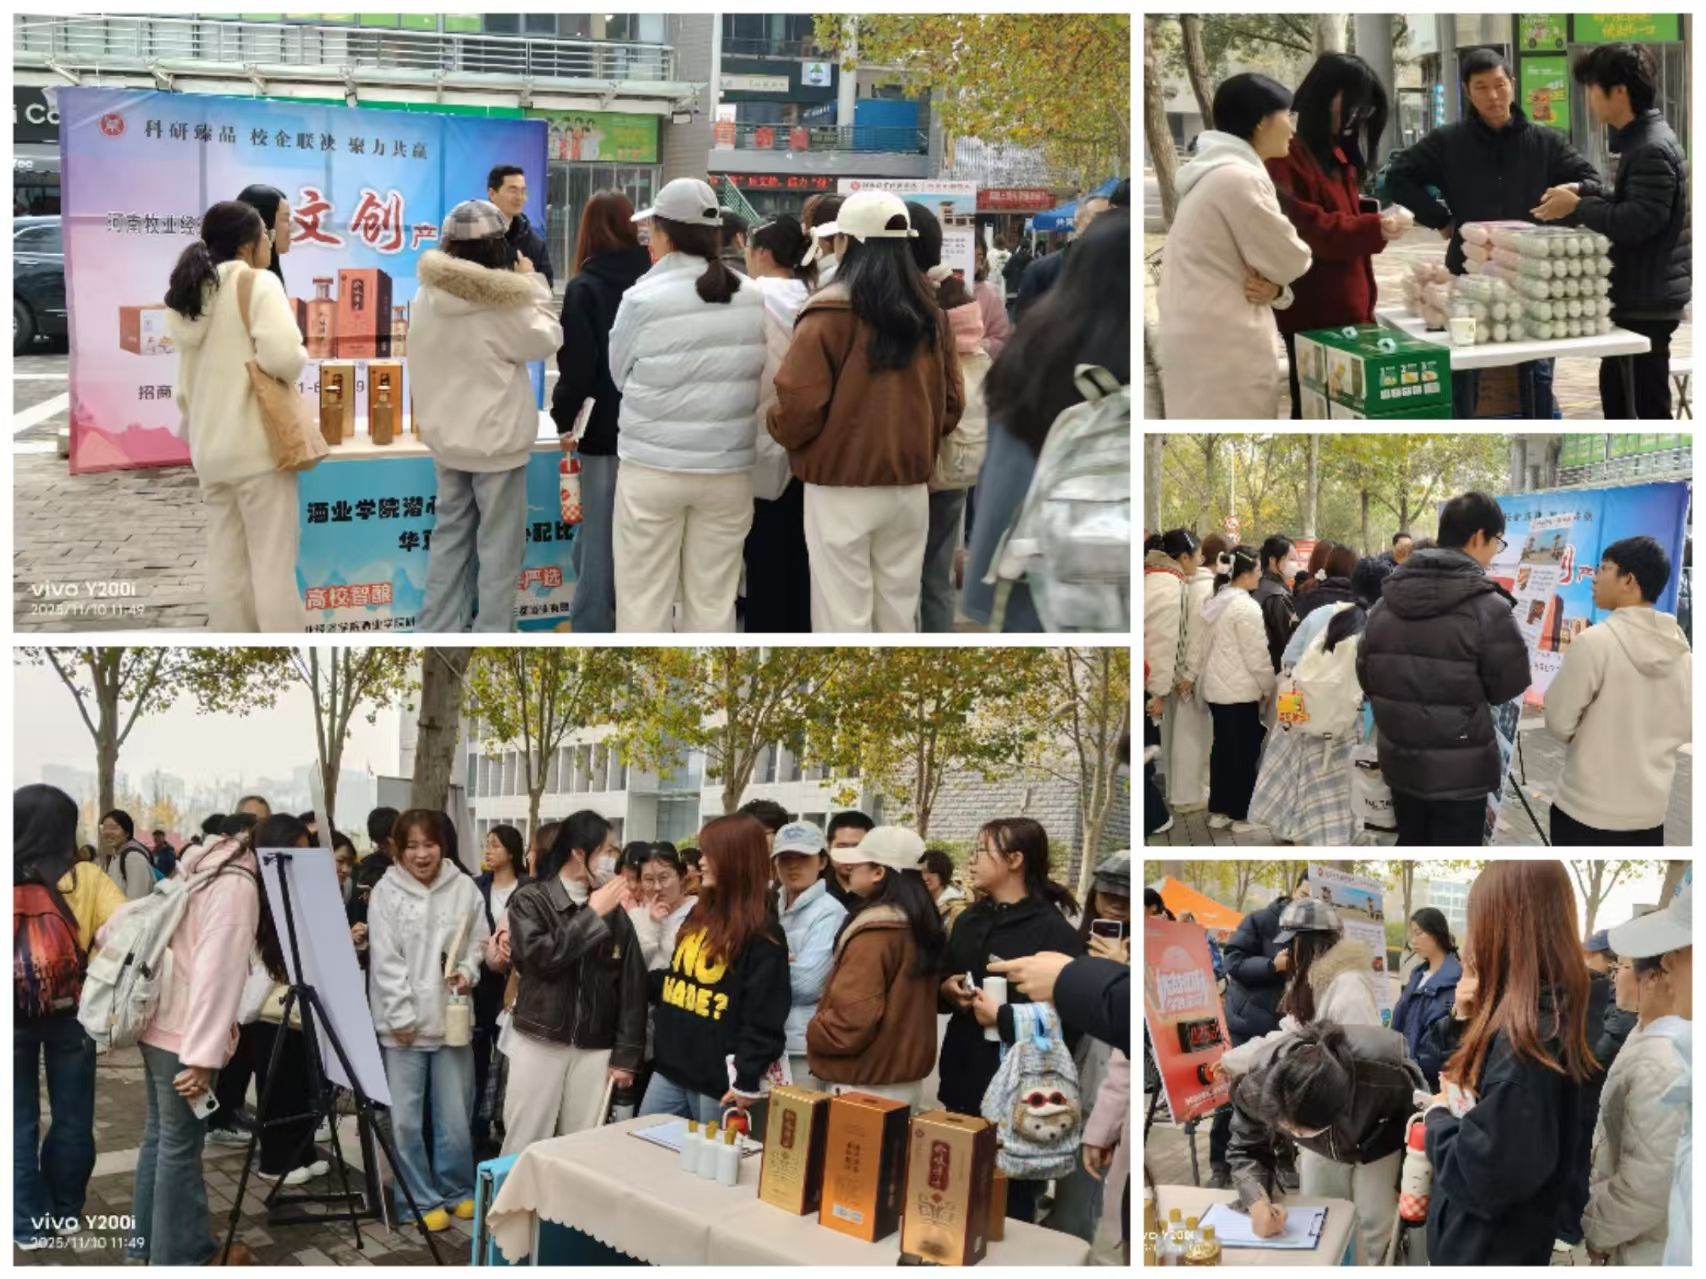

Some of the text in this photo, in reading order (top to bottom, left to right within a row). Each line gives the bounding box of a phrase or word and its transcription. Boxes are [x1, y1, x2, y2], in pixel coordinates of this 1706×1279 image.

[144, 119, 429, 160] 科研臻品 校企联袂 聚力共赢
[138, 385, 173, 400] 招商
[306, 583, 393, 610] 高校智酿
